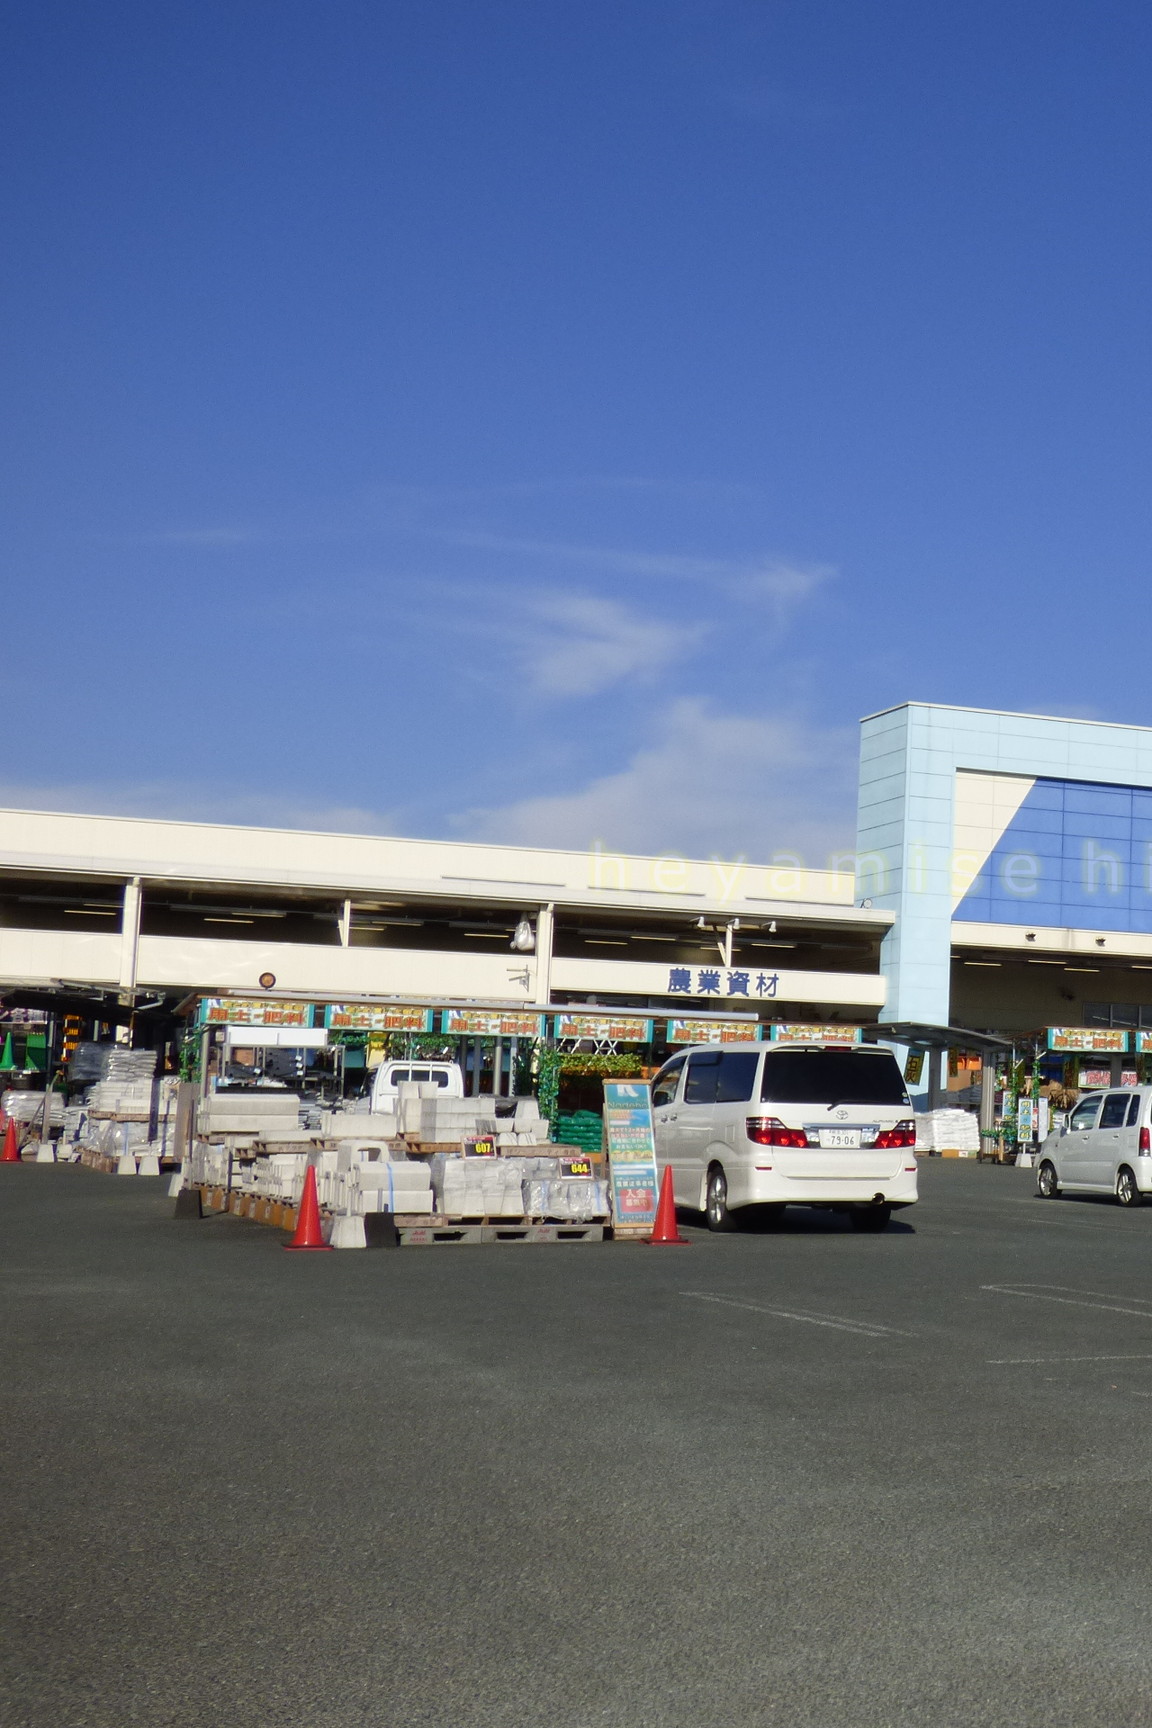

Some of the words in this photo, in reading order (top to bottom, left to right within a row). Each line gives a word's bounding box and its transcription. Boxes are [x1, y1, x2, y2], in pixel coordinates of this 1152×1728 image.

[667, 967, 779, 998] 農業資材
[830, 1135, 855, 1145] 79-06
[475, 1143, 491, 1153] 607
[571, 1163, 588, 1174] 644
